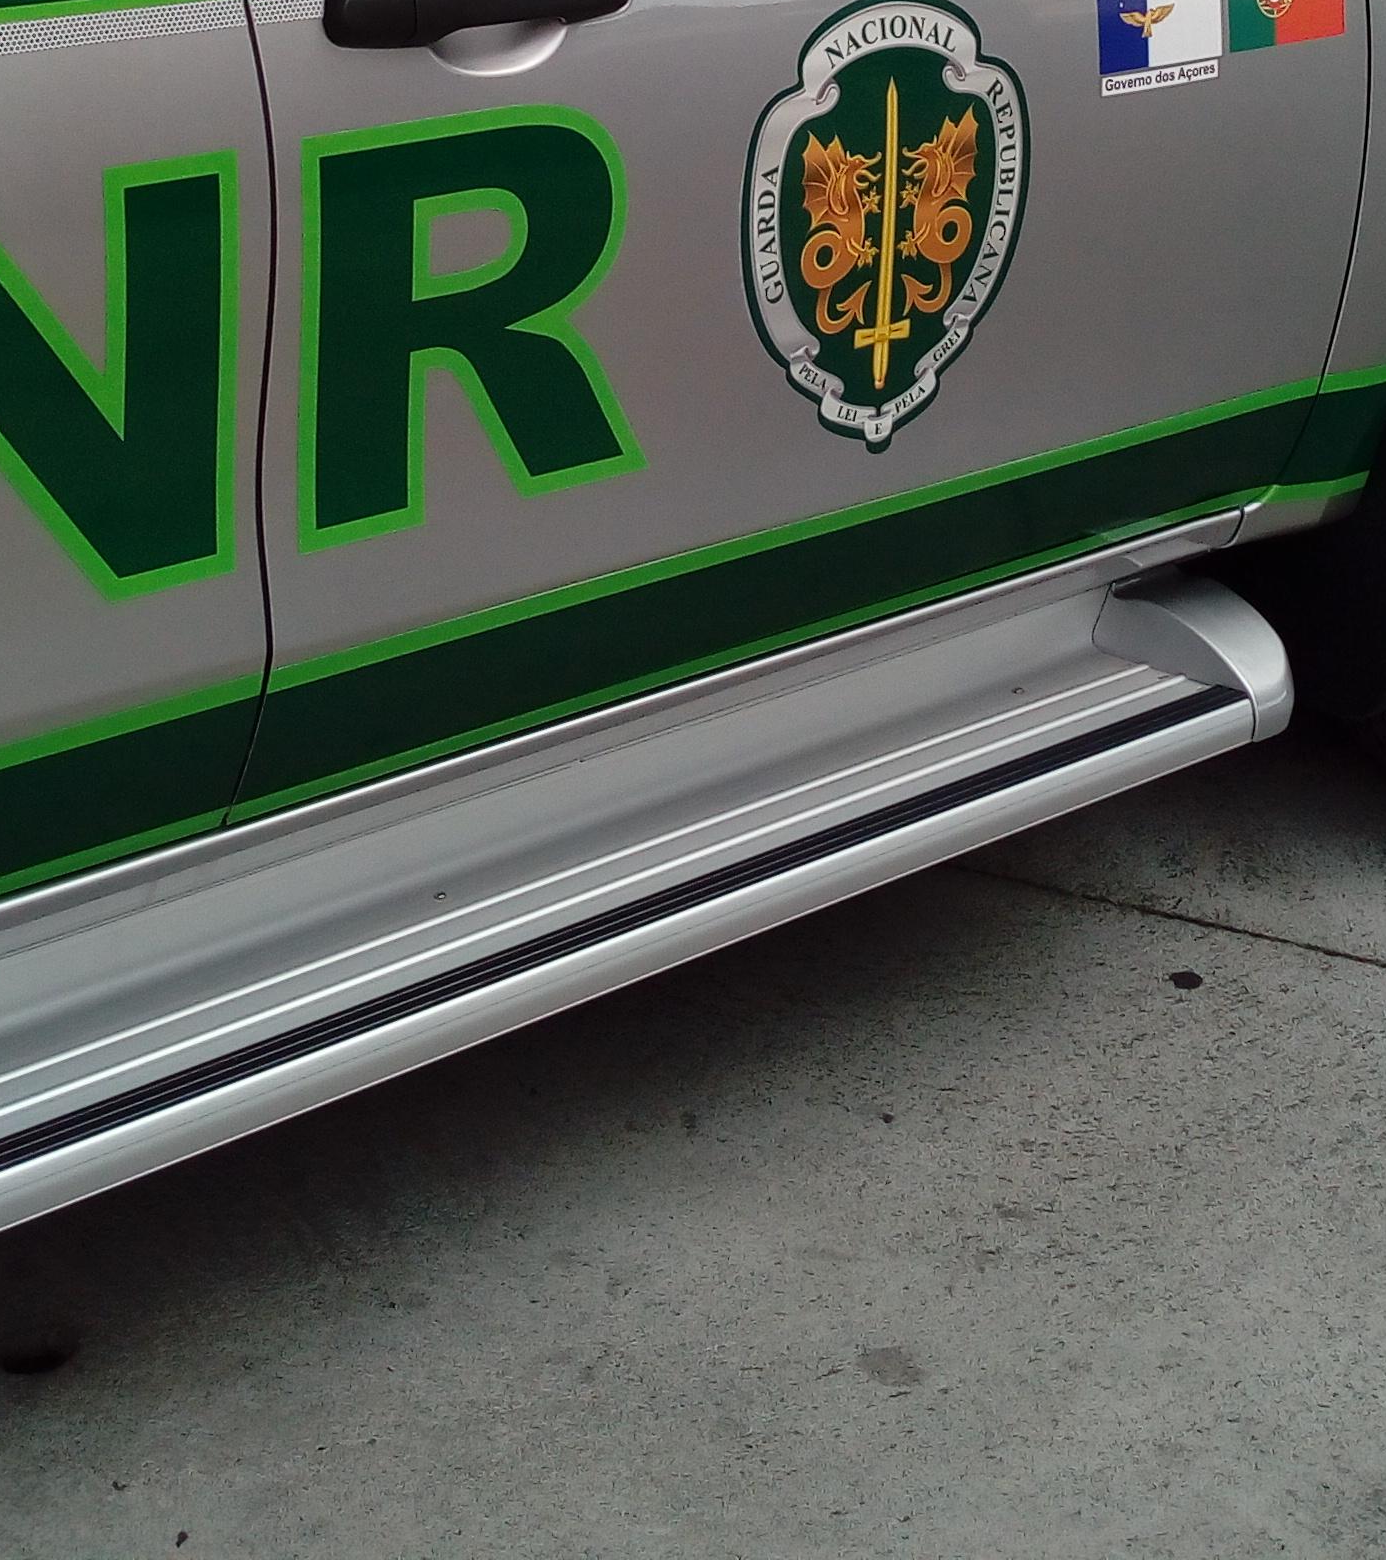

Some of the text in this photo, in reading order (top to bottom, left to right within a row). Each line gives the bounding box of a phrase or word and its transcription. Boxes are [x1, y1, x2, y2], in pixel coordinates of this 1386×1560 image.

[824, 15, 957, 69] NACIONAL
[1105, 64, 1215, 91] Governo dos Açores
[960, 78, 1016, 302] REPUBLICANA
[756, 165, 784, 303] GUARDA
[798, 365, 827, 391] PELA
[894, 384, 926, 414] PELA
[837, 404, 859, 423] LEI
[875, 422, 884, 436] E
